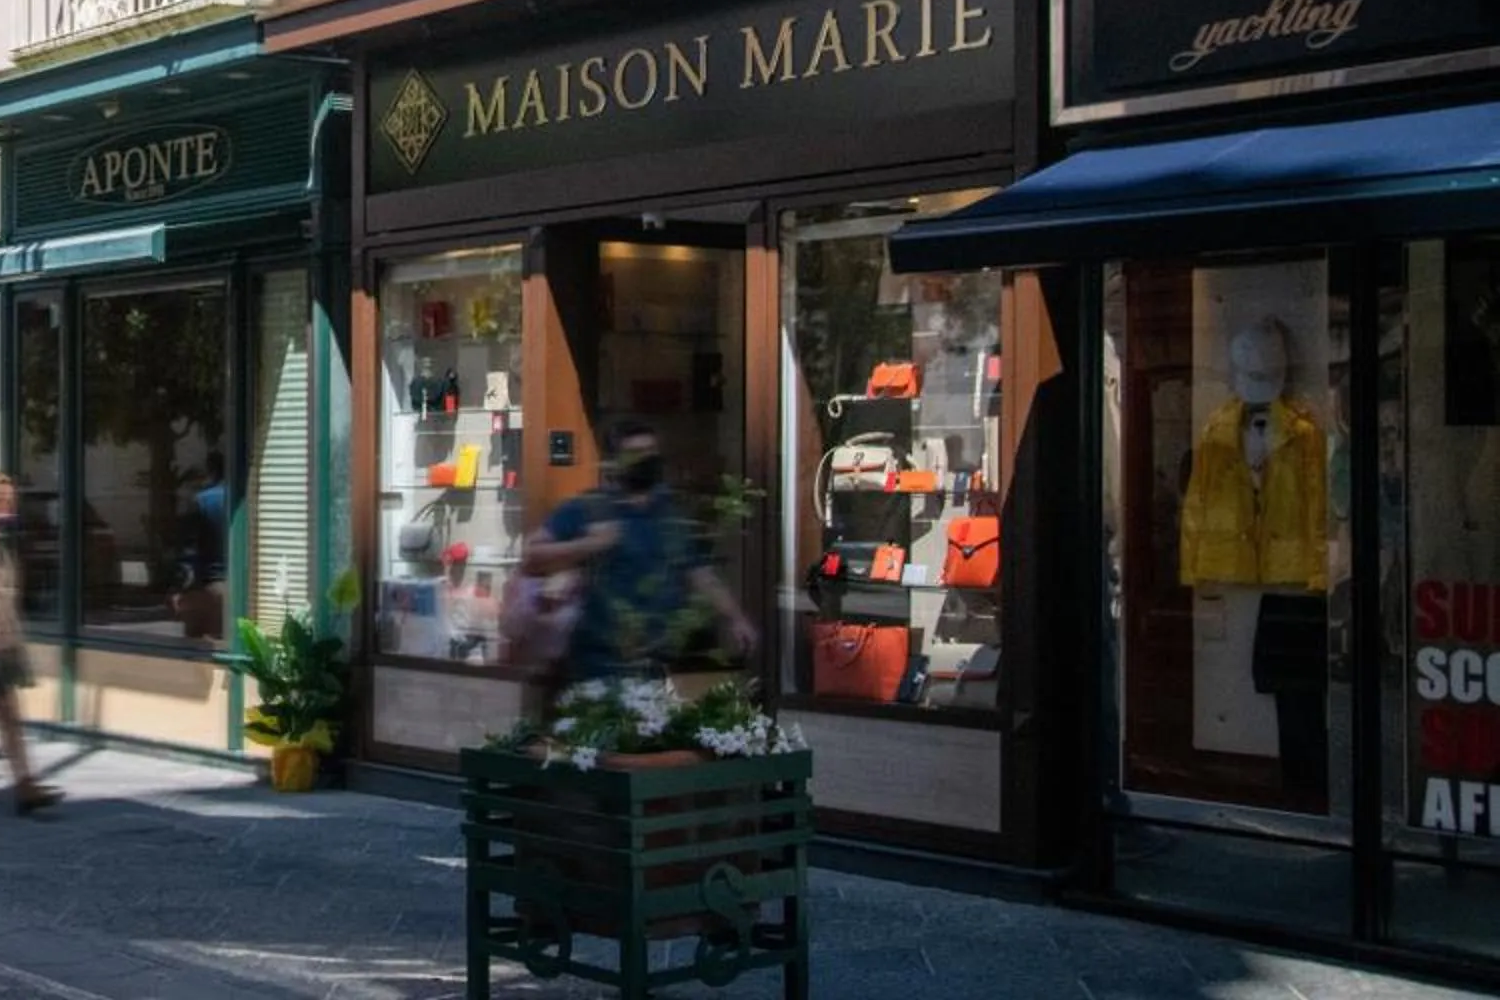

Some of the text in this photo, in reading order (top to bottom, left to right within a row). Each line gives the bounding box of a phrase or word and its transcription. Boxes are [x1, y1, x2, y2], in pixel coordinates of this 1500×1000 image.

[462, 33, 709, 139] MAISON
[80, 131, 218, 197] APONTE
[1415, 578, 1500, 644] SU
